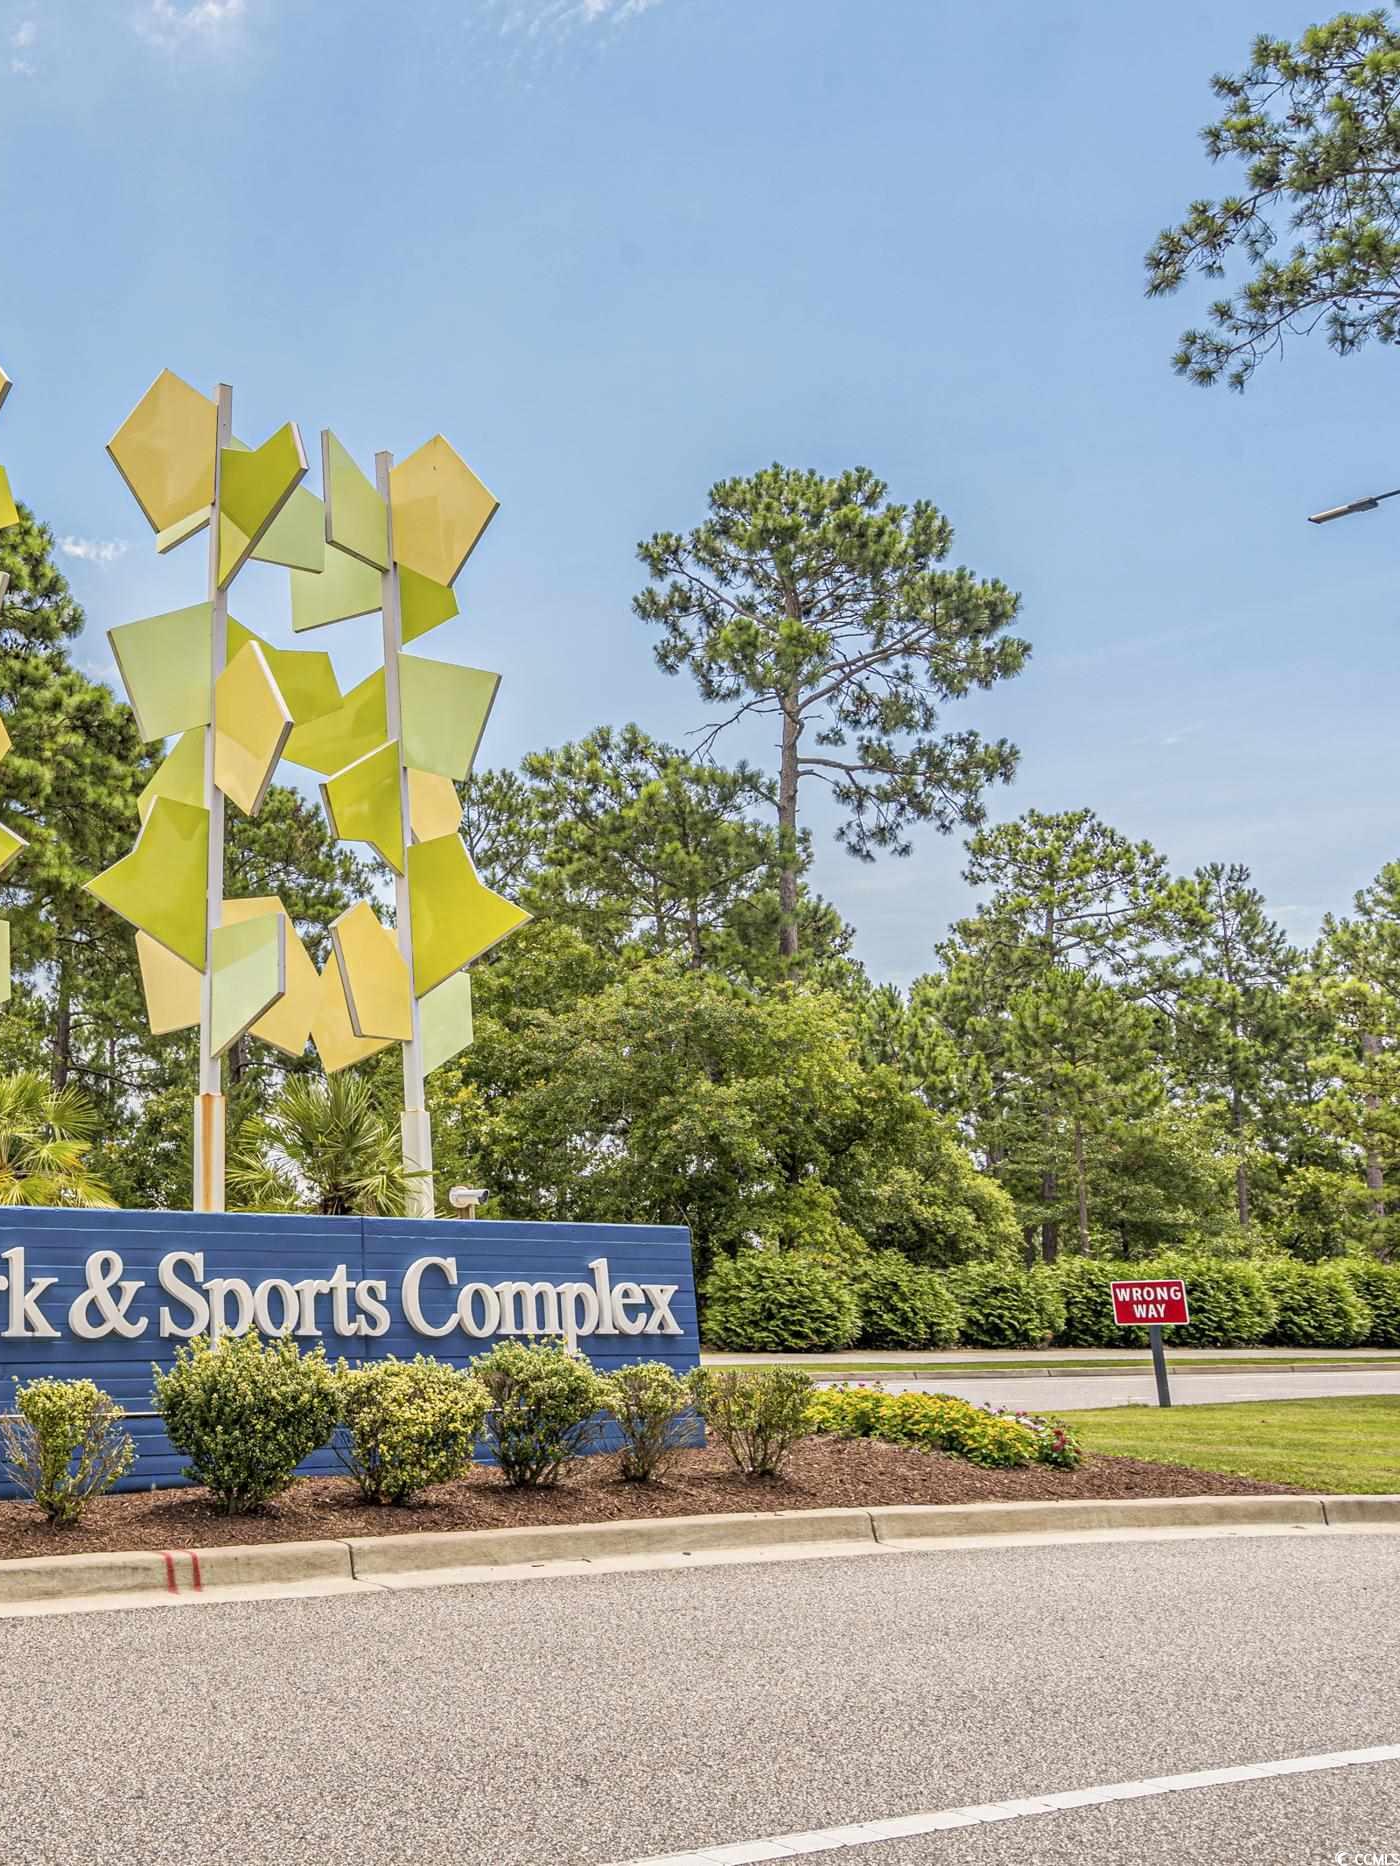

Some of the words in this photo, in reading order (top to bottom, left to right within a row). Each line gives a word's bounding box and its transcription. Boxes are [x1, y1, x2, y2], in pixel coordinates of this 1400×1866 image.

[1116, 1286, 1182, 1302] WRONG
[68, 1249, 149, 1339] &
[158, 1251, 391, 1352] Sports
[402, 1256, 684, 1357] Complex
[1133, 1303, 1166, 1318] WAY
